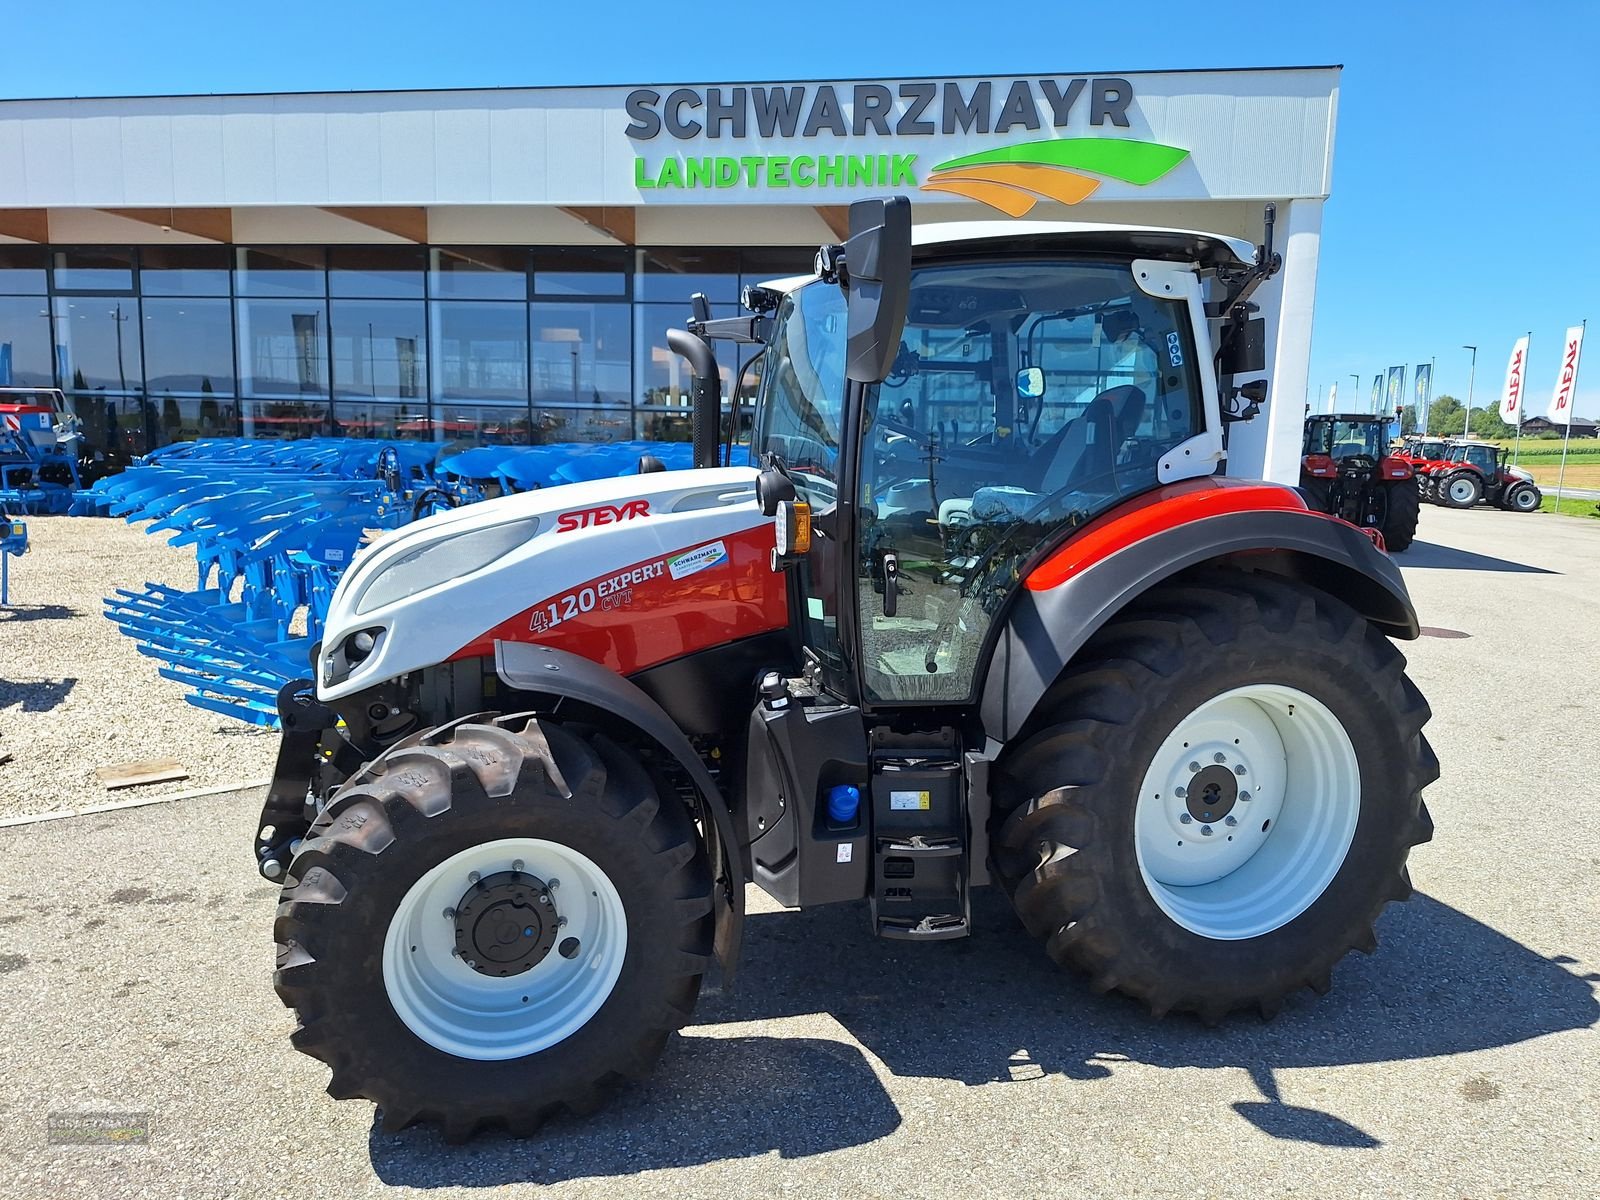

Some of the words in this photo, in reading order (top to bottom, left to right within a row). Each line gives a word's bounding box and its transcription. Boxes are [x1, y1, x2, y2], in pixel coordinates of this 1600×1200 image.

[625, 78, 1134, 140] SCHWARZMAYR
[634, 154, 919, 188] LANDTECHNIK
[556, 499, 651, 534] STEYR
[673, 548, 718, 567] SCHWARZMAYR
[529, 587, 597, 634] 4120
[597, 560, 665, 598] EXPERT
[601, 588, 633, 612] CVT
